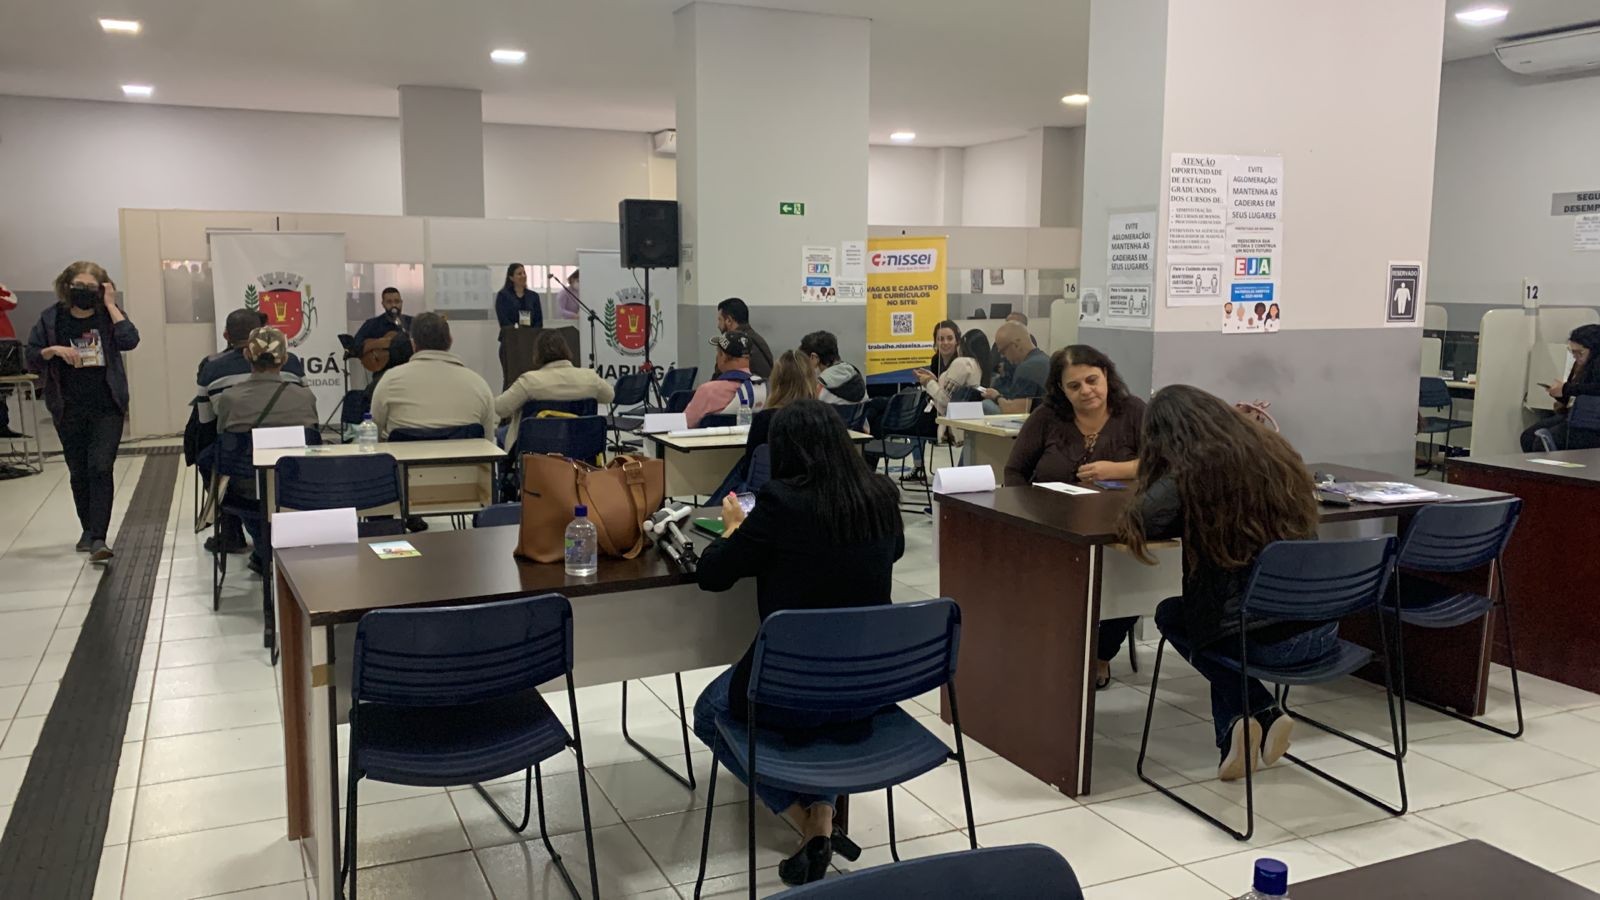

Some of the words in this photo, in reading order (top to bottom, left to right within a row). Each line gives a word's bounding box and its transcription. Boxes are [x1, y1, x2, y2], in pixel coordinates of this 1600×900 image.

[1182, 157, 1216, 167] ATENÇÃO
[1171, 167, 1223, 175] OPORTUNIDADE
[1233, 176, 1278, 184] AGLOMERAÇÃO!
[1171, 186, 1217, 194] GRADUANDOS
[1577, 193, 1600, 201] SEGU
[1563, 204, 1600, 213] DESEMP
[1232, 211, 1248, 219] SEUS
[1248, 211, 1276, 219] LUGARES
[1112, 233, 1151, 241] AGLOMERAÇÃO!
[887, 254, 932, 266] nissei
[808, 264, 830, 274] EJA
[1235, 257, 1271, 276] EJA
[1066, 283, 1076, 293] 16
[1526, 285, 1539, 300] 12
[589, 361, 677, 381] MARIG
[307, 378, 341, 387] CIDADE
